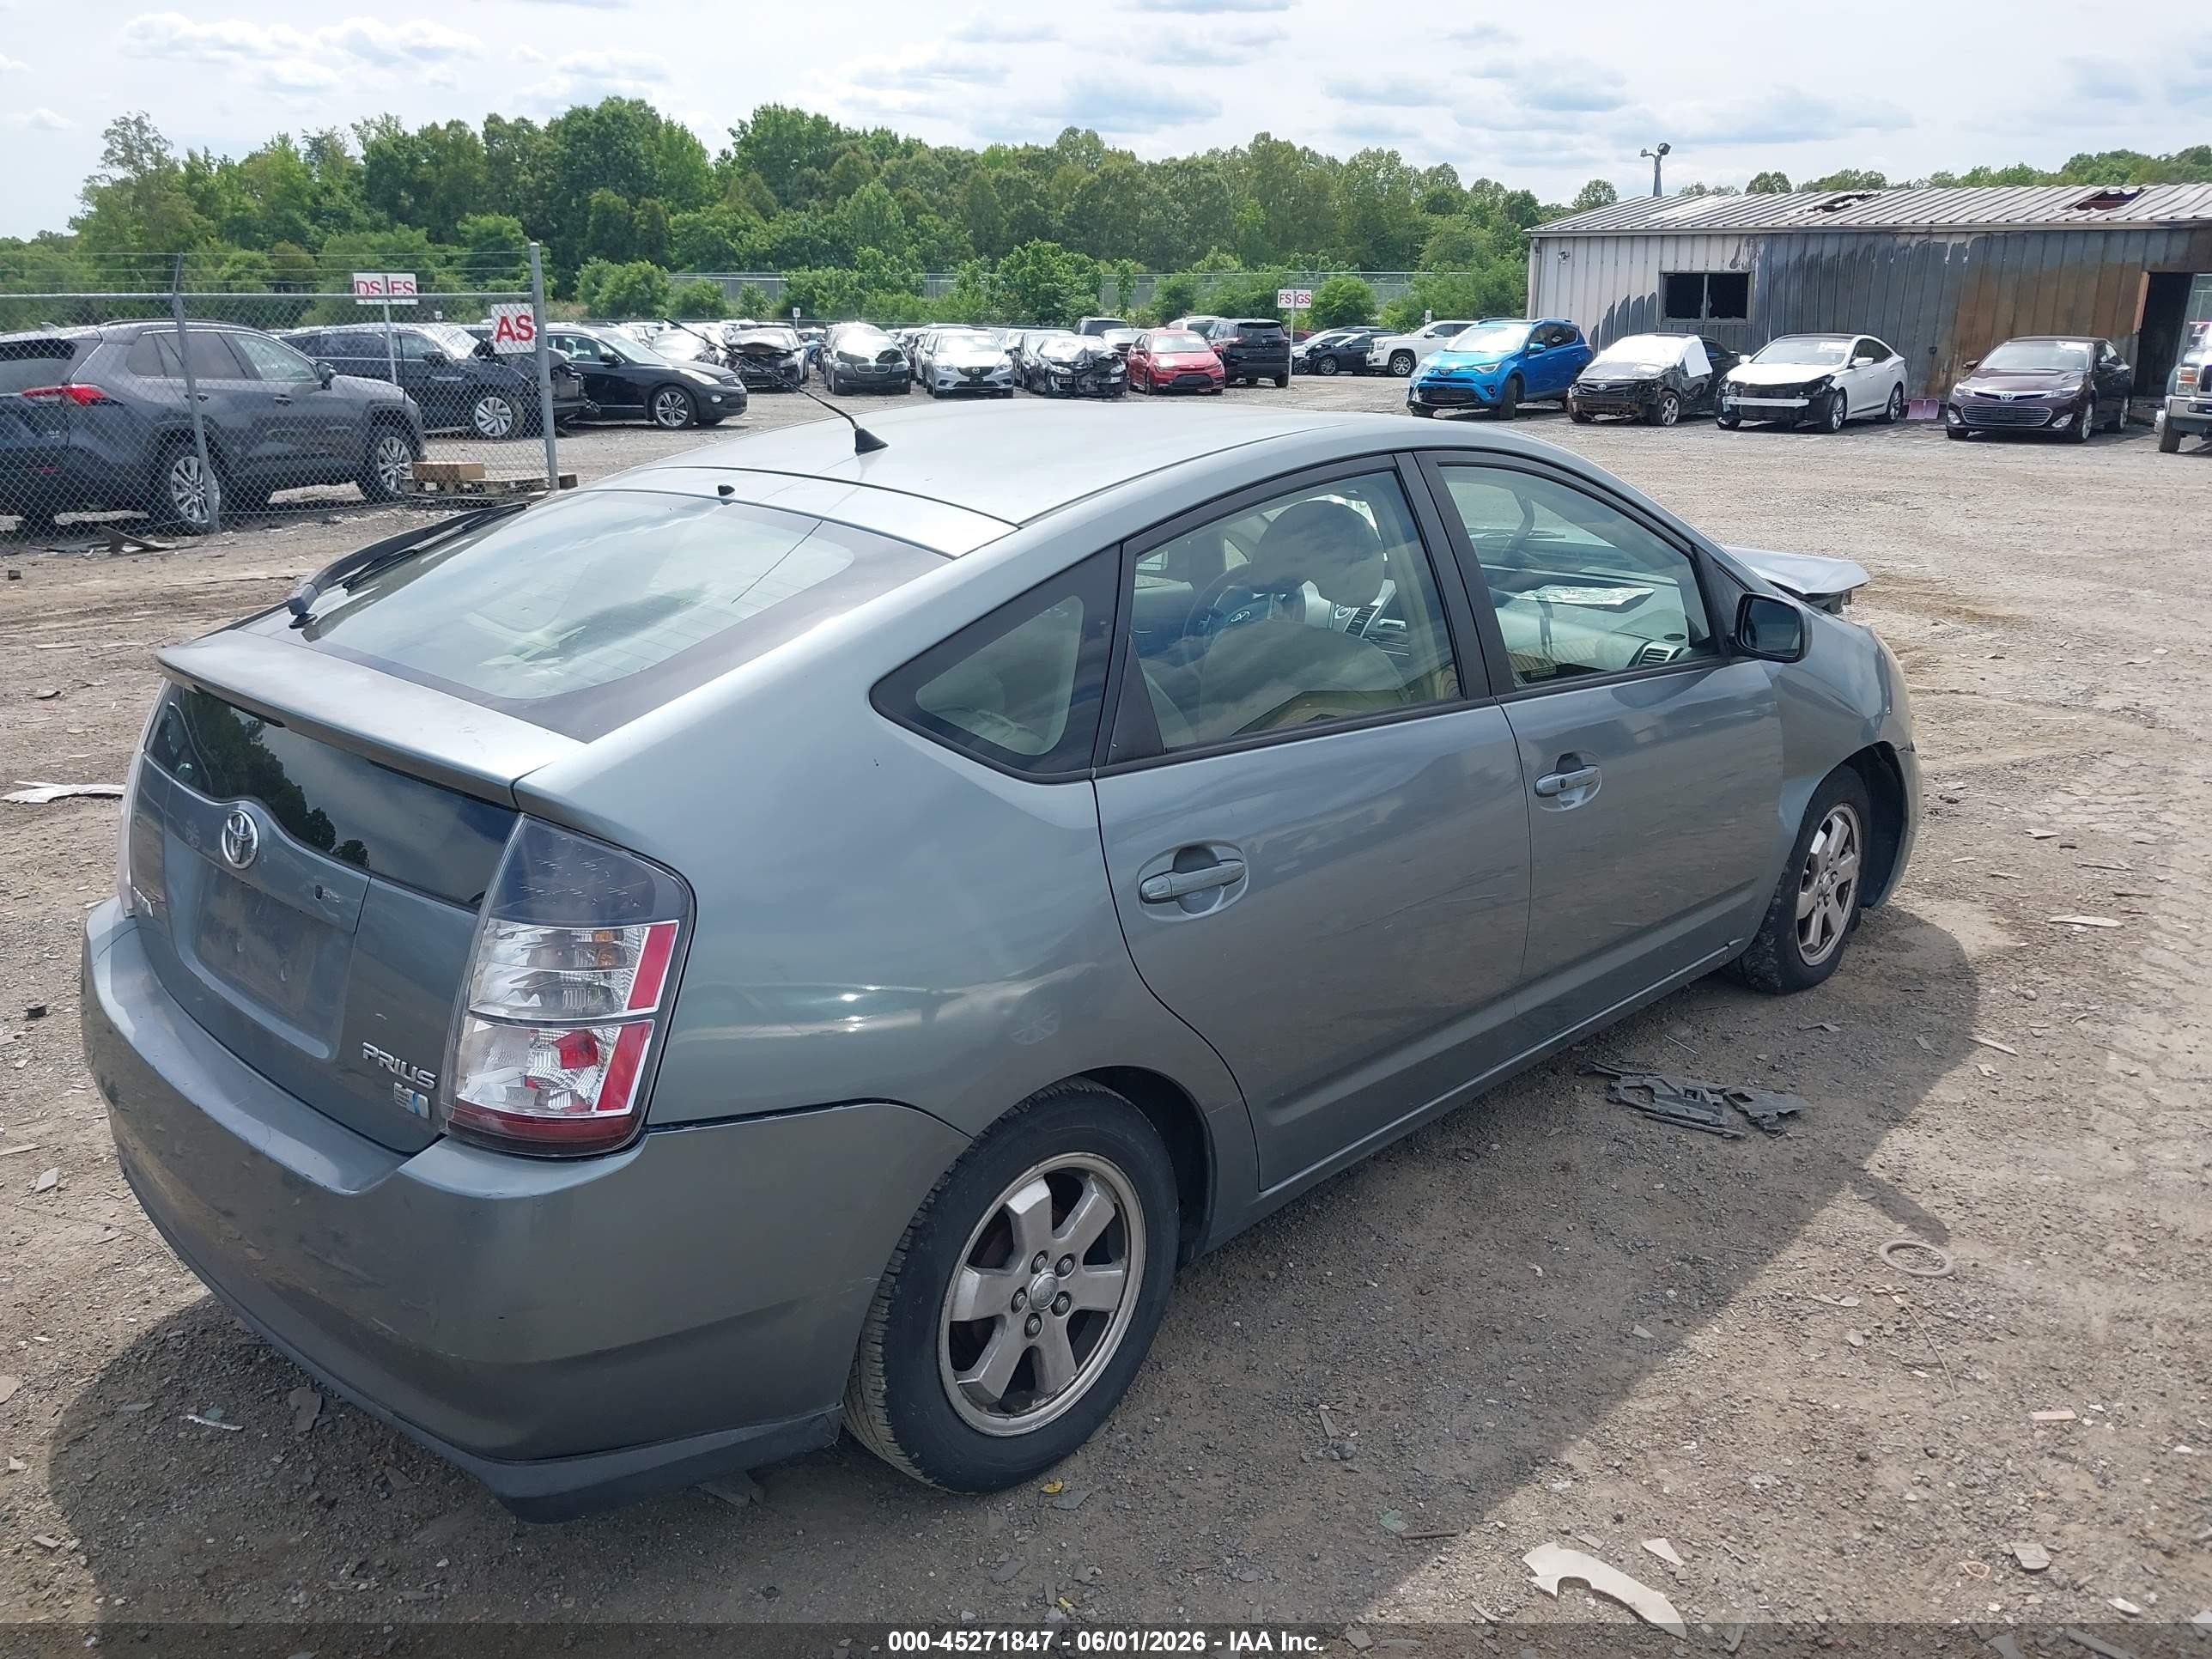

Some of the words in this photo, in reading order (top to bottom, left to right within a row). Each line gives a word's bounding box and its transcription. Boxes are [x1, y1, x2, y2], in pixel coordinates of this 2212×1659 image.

[356, 280, 382, 295] DS
[1279, 293, 1292, 304] FS
[1297, 293, 1311, 304] GS
[495, 314, 534, 343] AS
[362, 1042, 437, 1090] PRIUS
